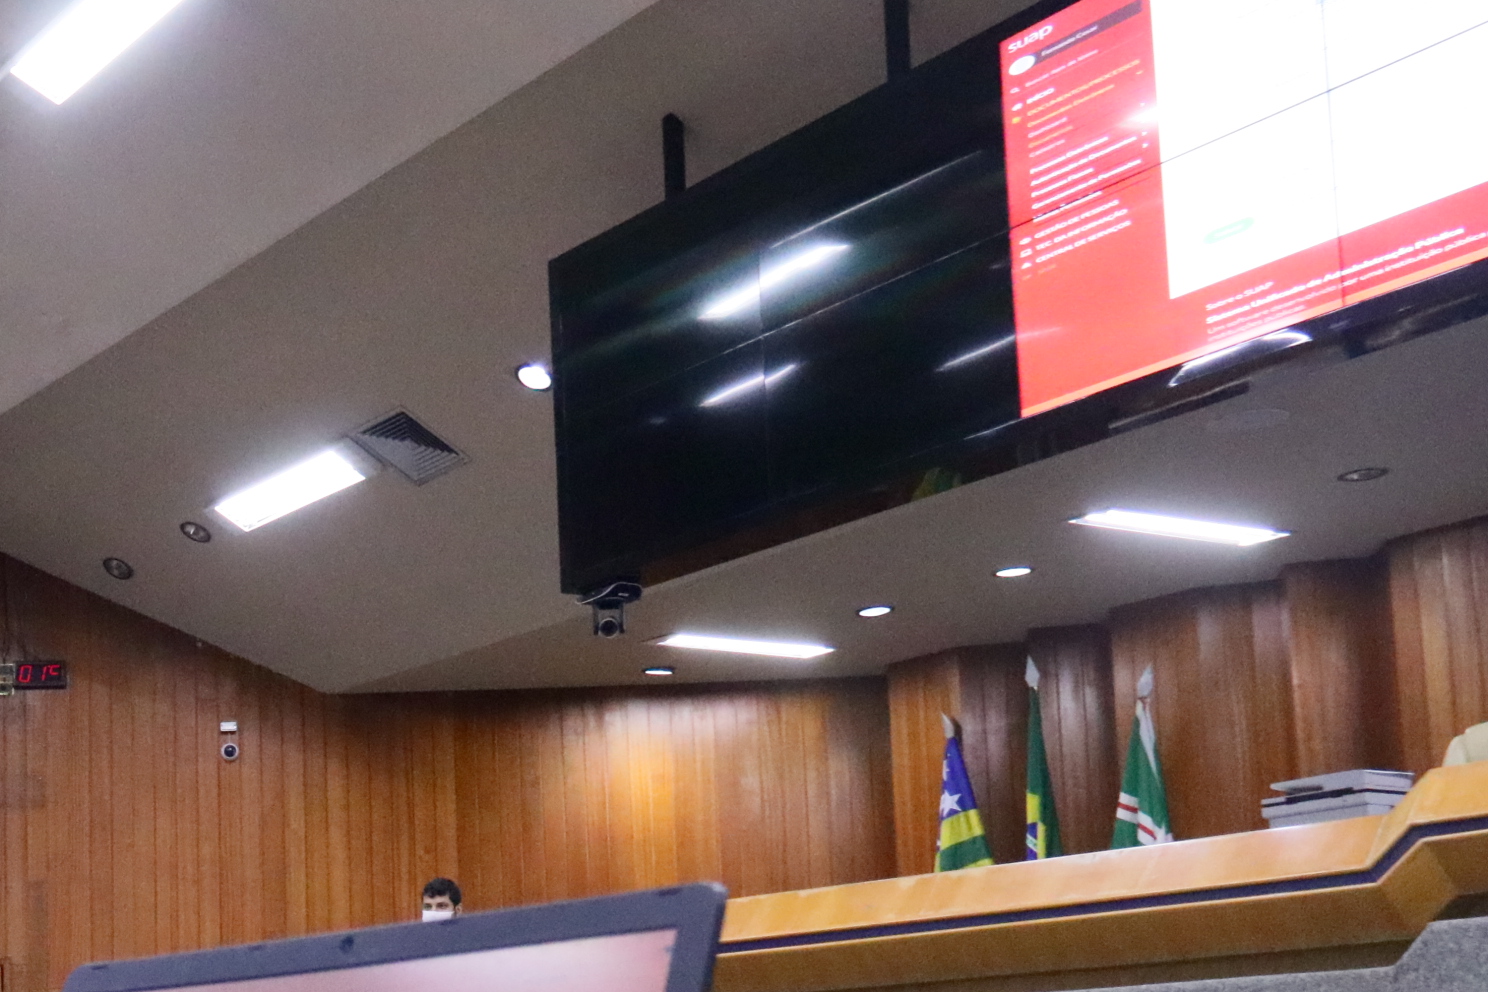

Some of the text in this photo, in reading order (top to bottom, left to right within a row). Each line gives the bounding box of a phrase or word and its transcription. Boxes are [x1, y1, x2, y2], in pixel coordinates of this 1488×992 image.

[1008, 24, 1054, 54] suap
[1034, 220, 1067, 238] GESTÃO
[1080, 199, 1118, 219] PESSOAS
[1067, 207, 1127, 237] INFORMAÇÃO
[1035, 244, 1073, 262] CENTRAL
[1087, 220, 1130, 241] SERVIÇOS
[1205, 303, 1250, 323] Sistema
[1250, 283, 1306, 307] Unificado
[1323, 243, 1414, 283] Administração
[1414, 225, 1464, 249] Pública
[1226, 308, 1269, 327] software
[1270, 285, 1336, 311] desenvolvido
[1359, 268, 1384, 281] uma
[1385, 244, 1443, 273] instituição
[1444, 230, 1486, 251] pública
[1205, 295, 1234, 310] Sobre
[1243, 281, 1272, 296] SUAP
